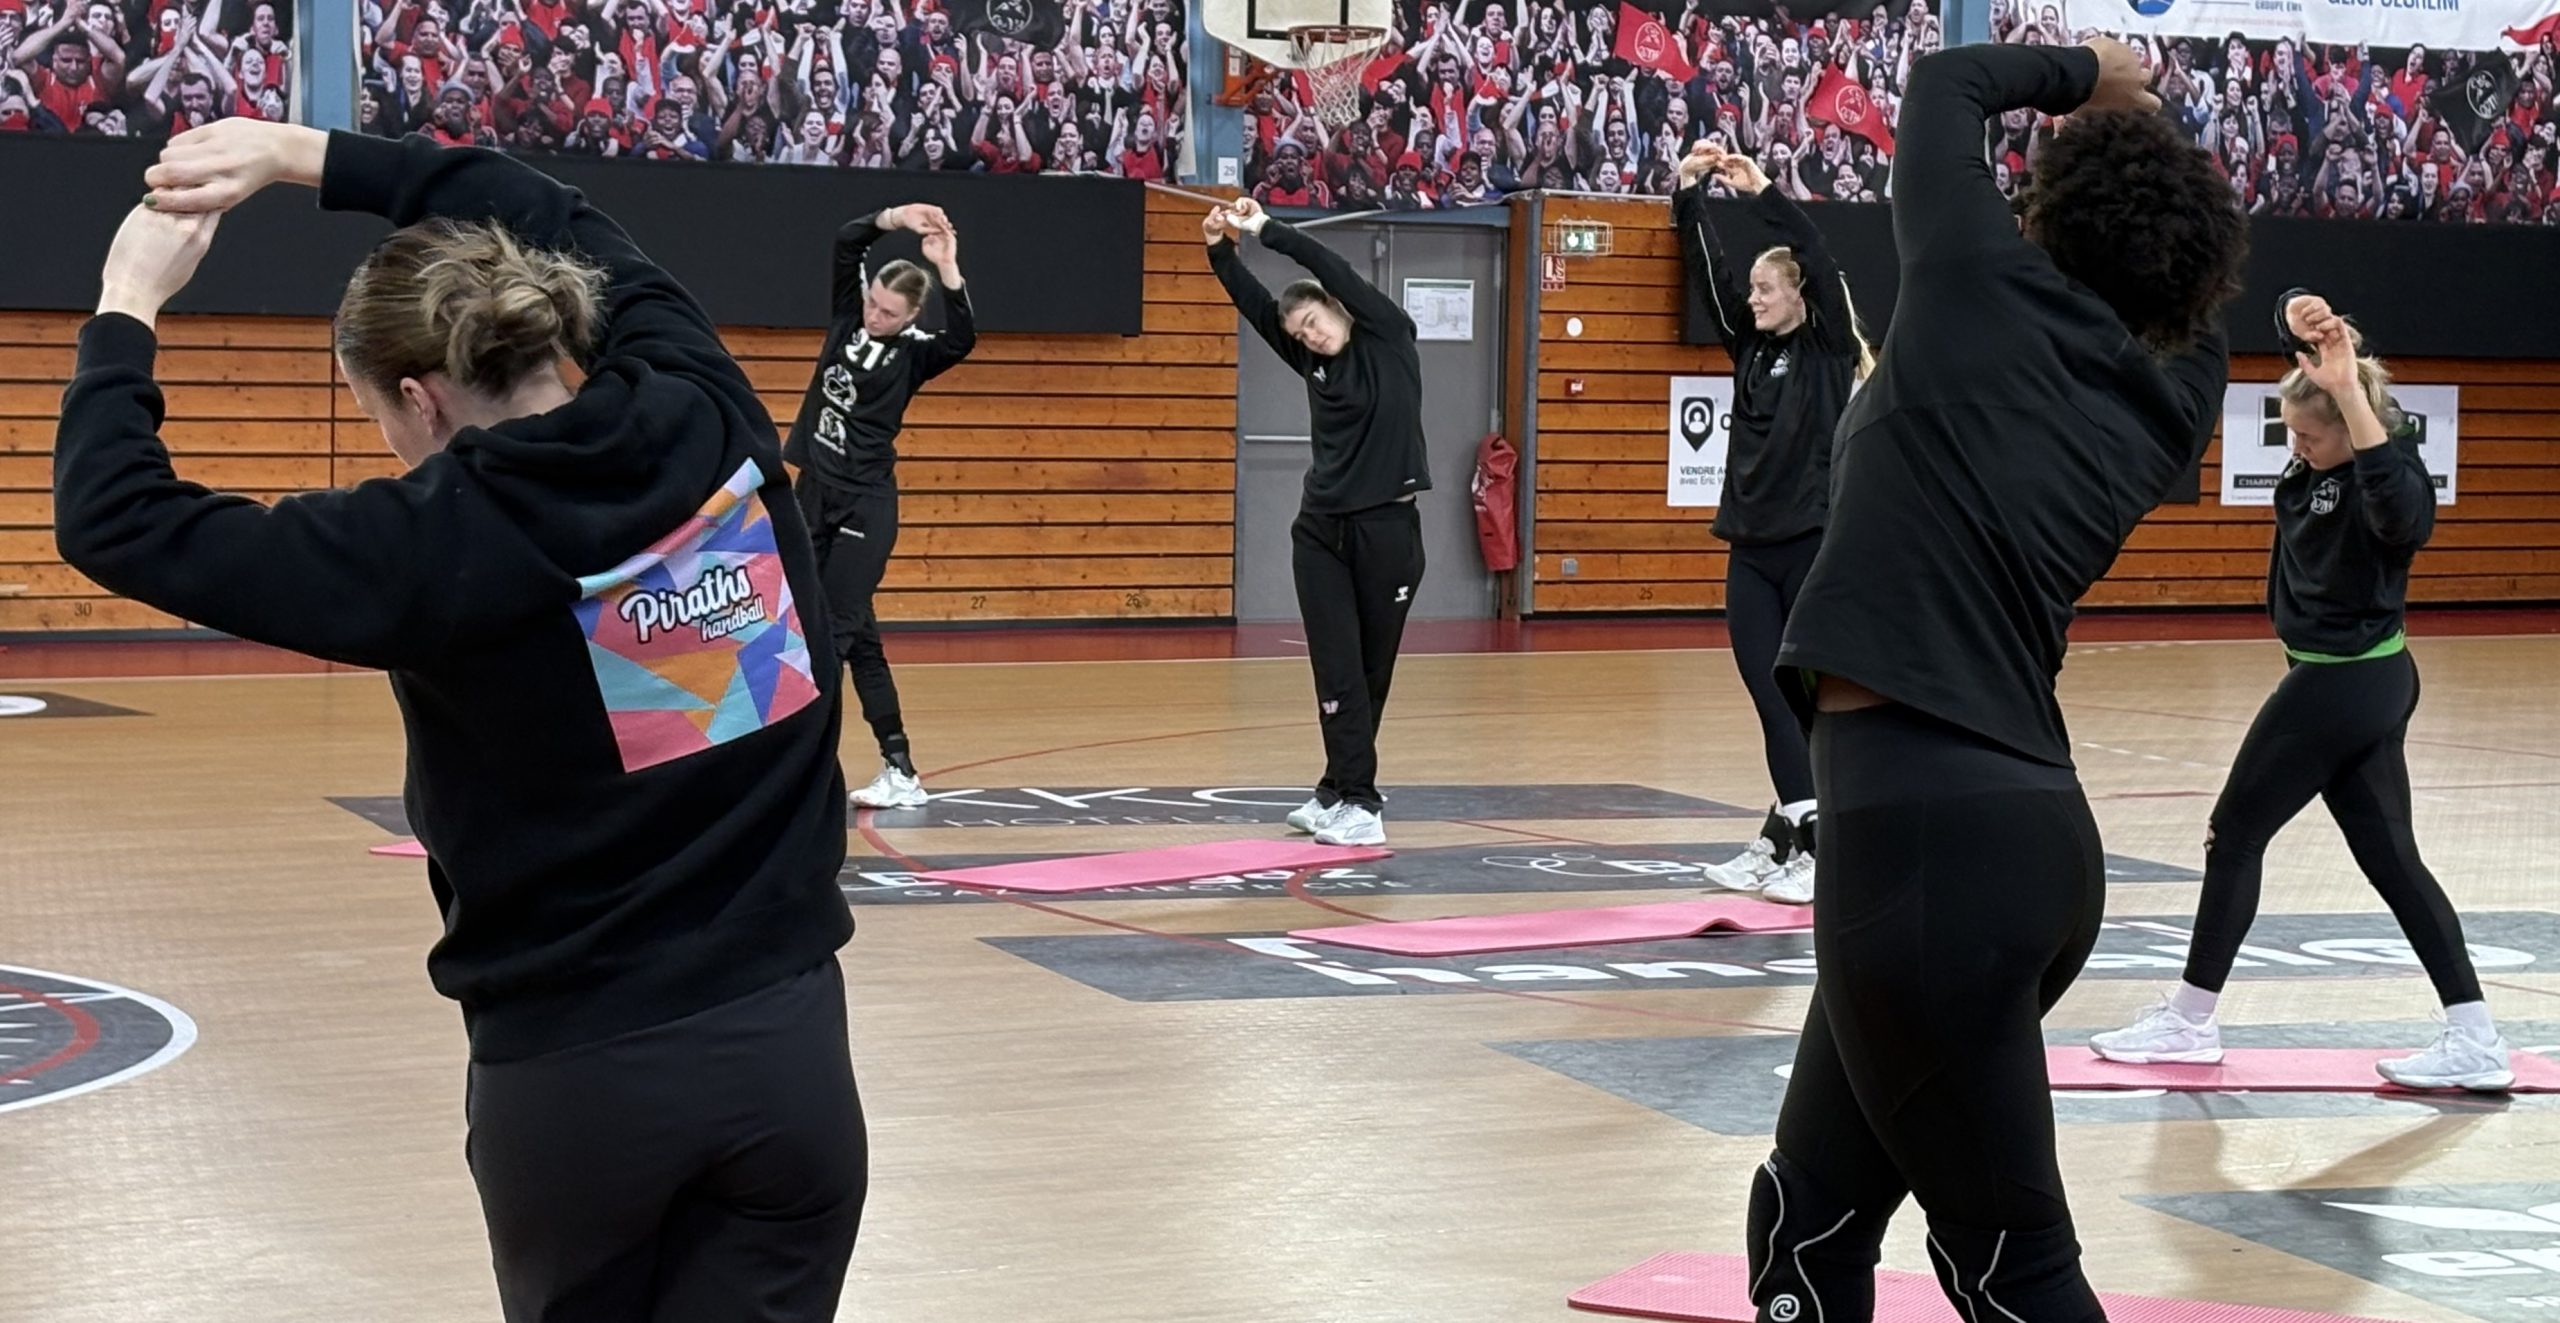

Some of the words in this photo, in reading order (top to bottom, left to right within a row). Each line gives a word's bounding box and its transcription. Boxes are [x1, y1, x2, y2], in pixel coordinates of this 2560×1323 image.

[1680, 465, 1716, 476] VENDRE
[74, 601, 92, 617] 30
[619, 566, 752, 643] Piraths
[971, 596, 986, 610] 27
[701, 596, 766, 642] handball
[943, 815, 1260, 828] HOTELS
[1103, 880, 1412, 893] ELECTRCITE
